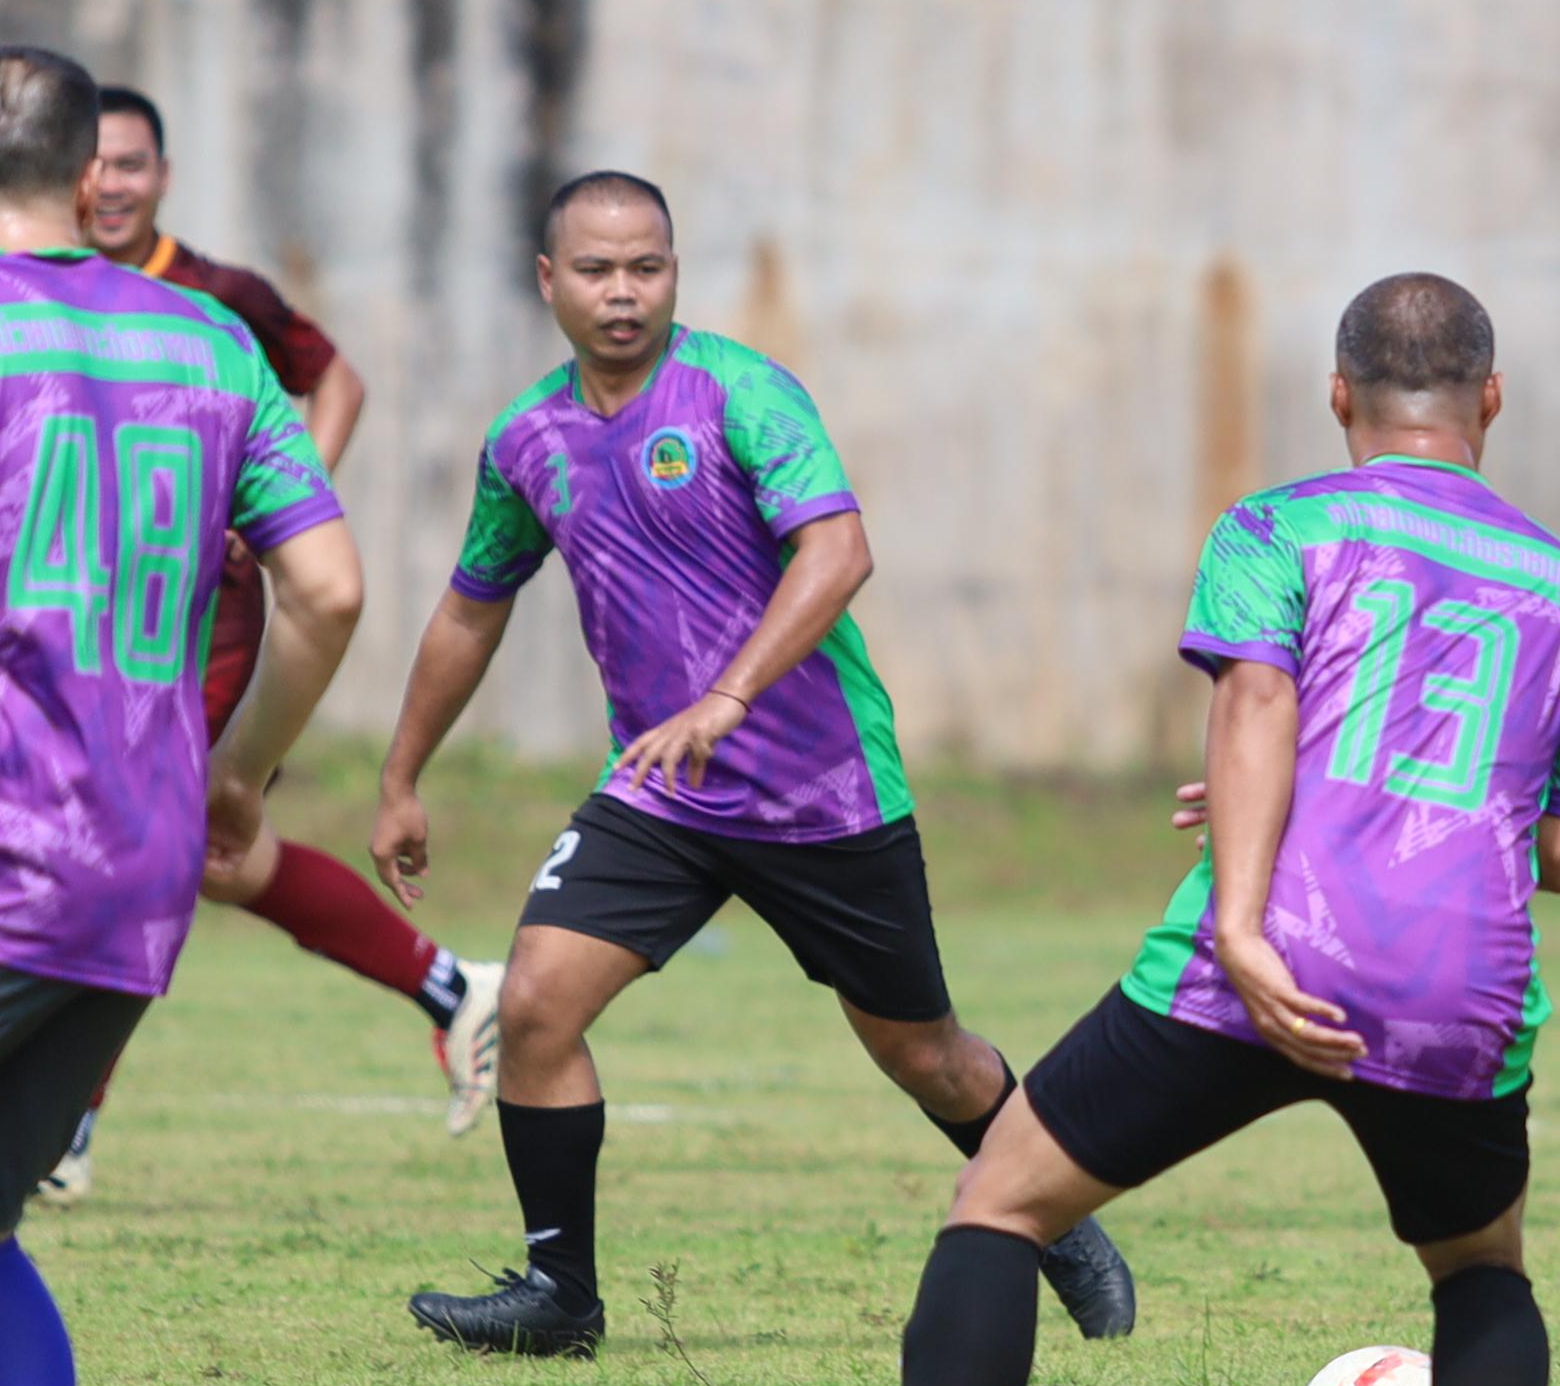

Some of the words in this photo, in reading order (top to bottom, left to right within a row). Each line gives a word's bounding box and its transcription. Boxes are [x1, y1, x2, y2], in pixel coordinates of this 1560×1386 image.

[7, 412, 203, 685] 48
[1325, 578, 1521, 813] 13
[529, 830, 581, 892] 2
